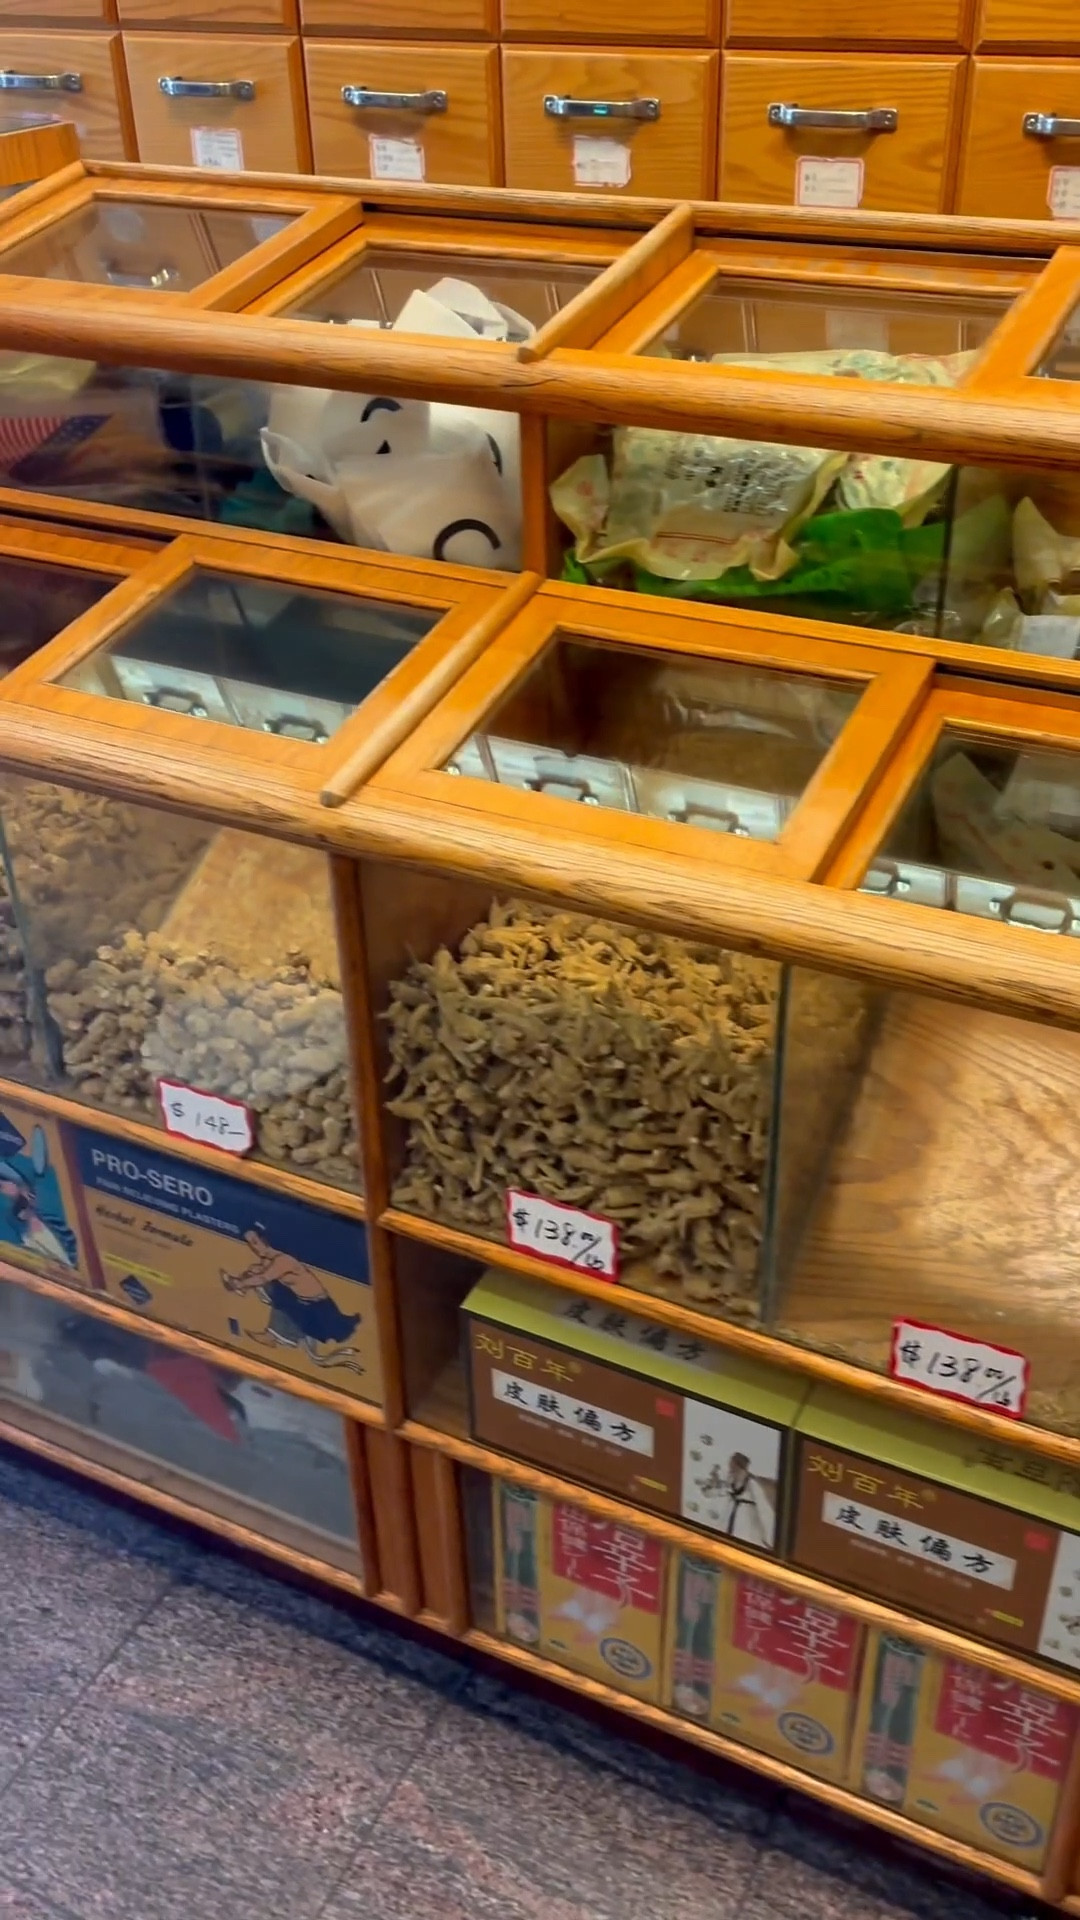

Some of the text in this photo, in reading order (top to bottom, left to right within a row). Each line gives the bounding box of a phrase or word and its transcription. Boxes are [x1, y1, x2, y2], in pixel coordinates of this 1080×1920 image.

[91, 1149, 213, 1206] PRO-SERO
[474, 1333, 574, 1383] 刘百年
[503, 1382, 636, 1442] 皮肤偏方
[806, 1455, 924, 1510] 刘百年
[836, 1505, 995, 1574] 皮肤偏方
